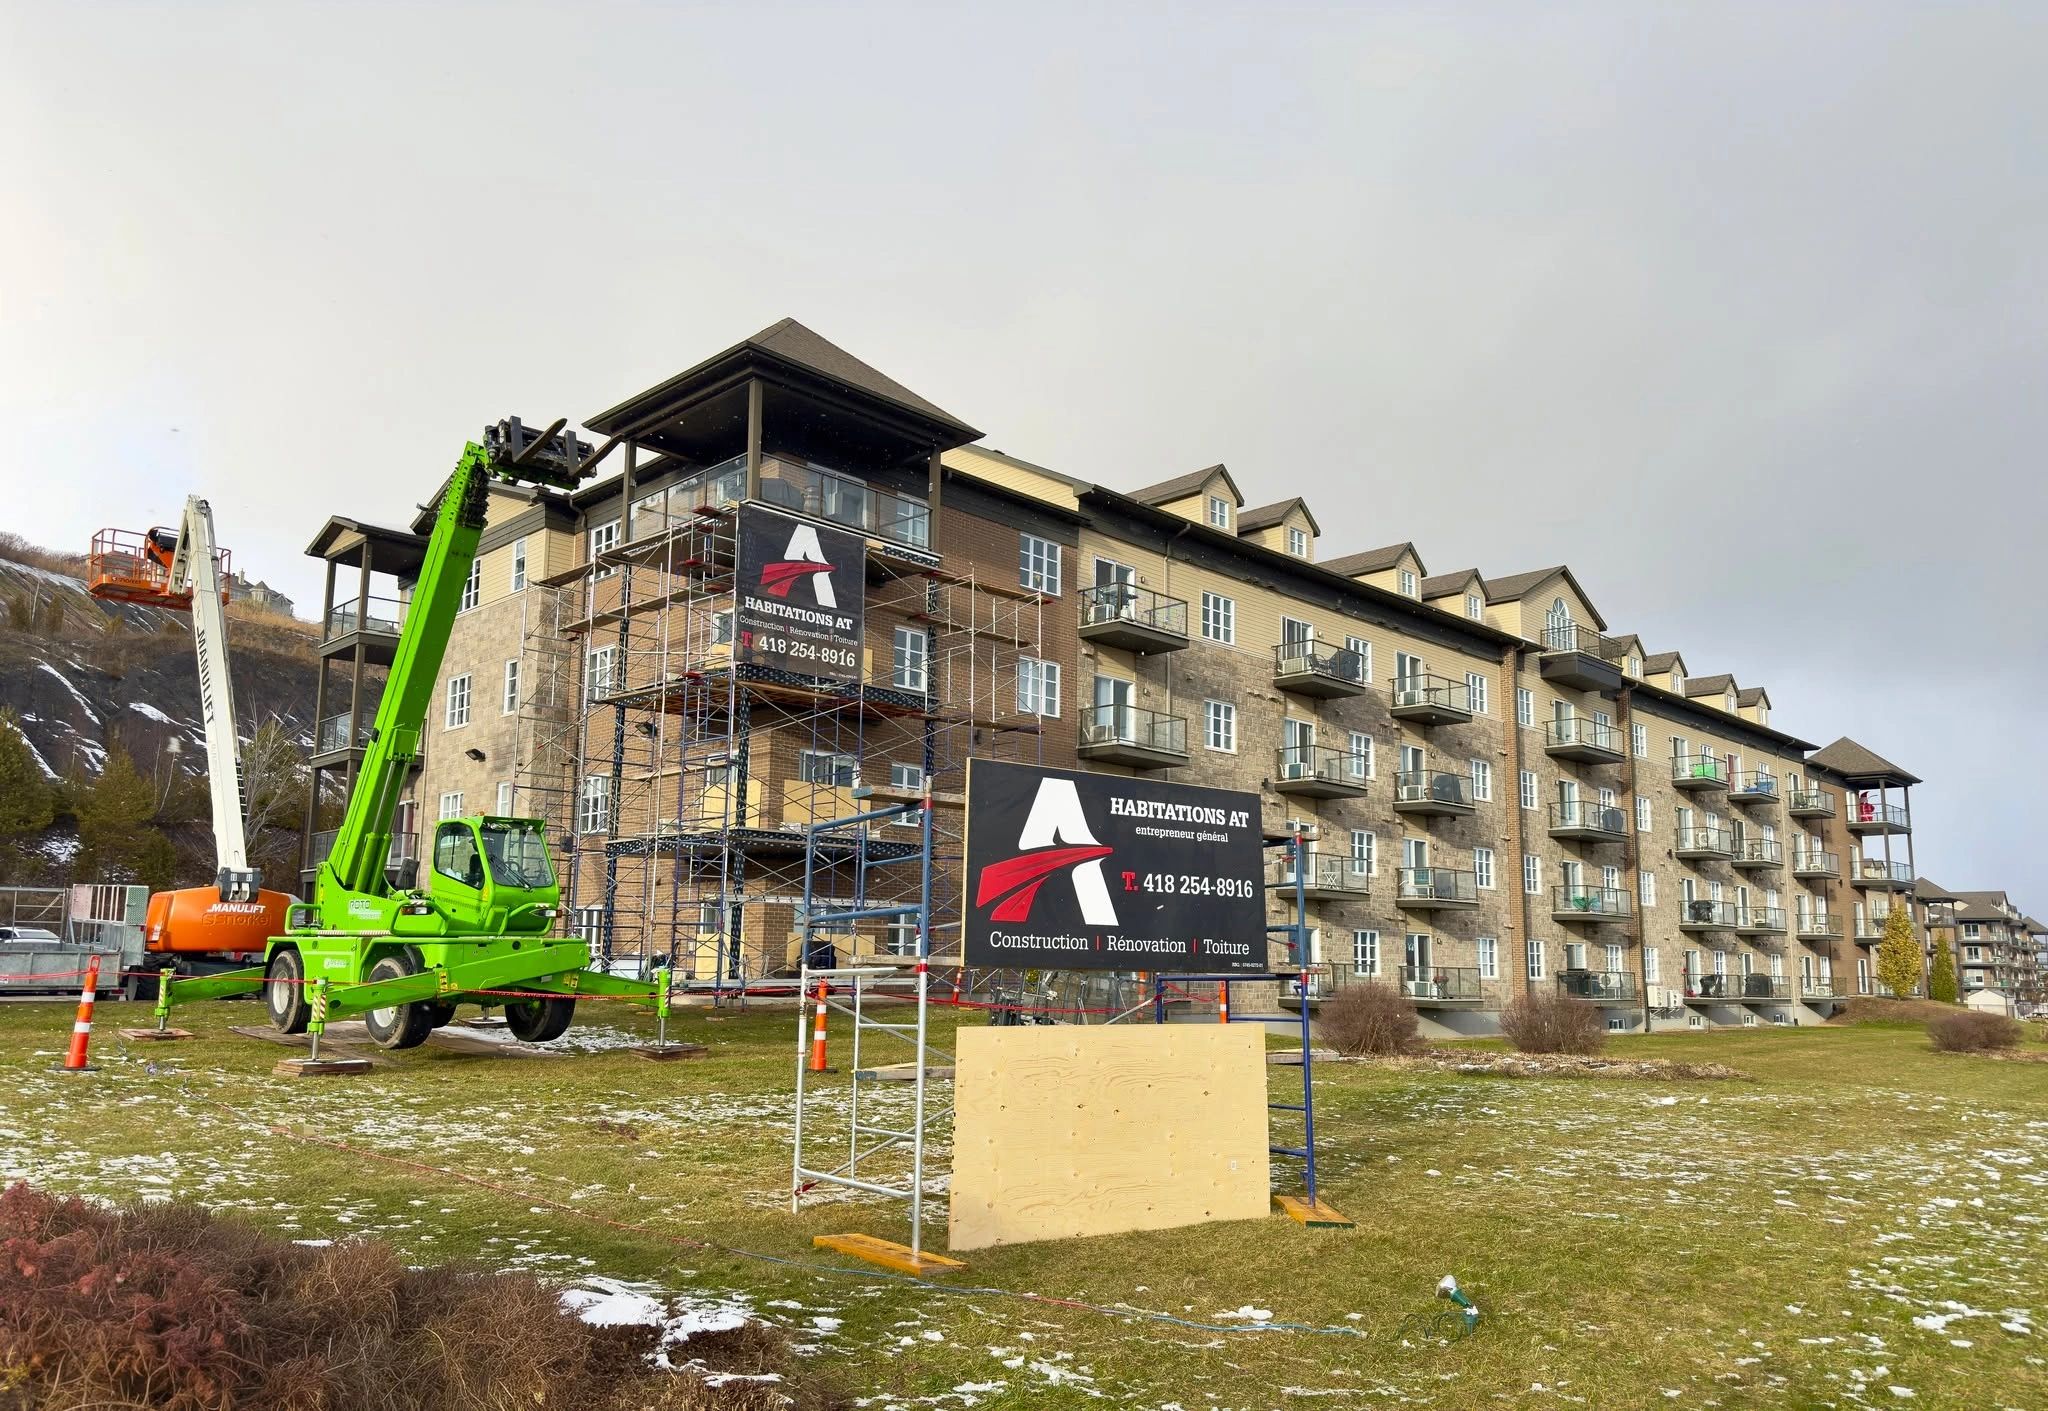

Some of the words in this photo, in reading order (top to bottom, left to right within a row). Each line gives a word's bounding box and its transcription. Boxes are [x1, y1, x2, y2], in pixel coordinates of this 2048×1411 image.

[744, 596, 833, 627] HABITATIONS
[835, 617, 853, 630] AT
[739, 615, 785, 632] Construction
[789, 626, 829, 641] Rénovation
[833, 634, 858, 647] Toiture
[758, 635, 786, 654] 418
[789, 641, 856, 667] 254-8916
[197, 627, 215, 725] MANULIFT
[1110, 797, 1226, 827] HABITATIONS
[1229, 811, 1249, 828] AT
[1135, 825, 1195, 841] entrepreneur
[1196, 828, 1229, 843] général
[1121, 871, 1140, 892] T.
[1143, 873, 1175, 893] 418
[1179, 875, 1253, 898] 254-8916
[207, 903, 266, 913] MANULIFT
[990, 931, 1089, 950] Construction
[1106, 935, 1187, 953] Rénovation
[1203, 938, 1250, 955] Toiture
